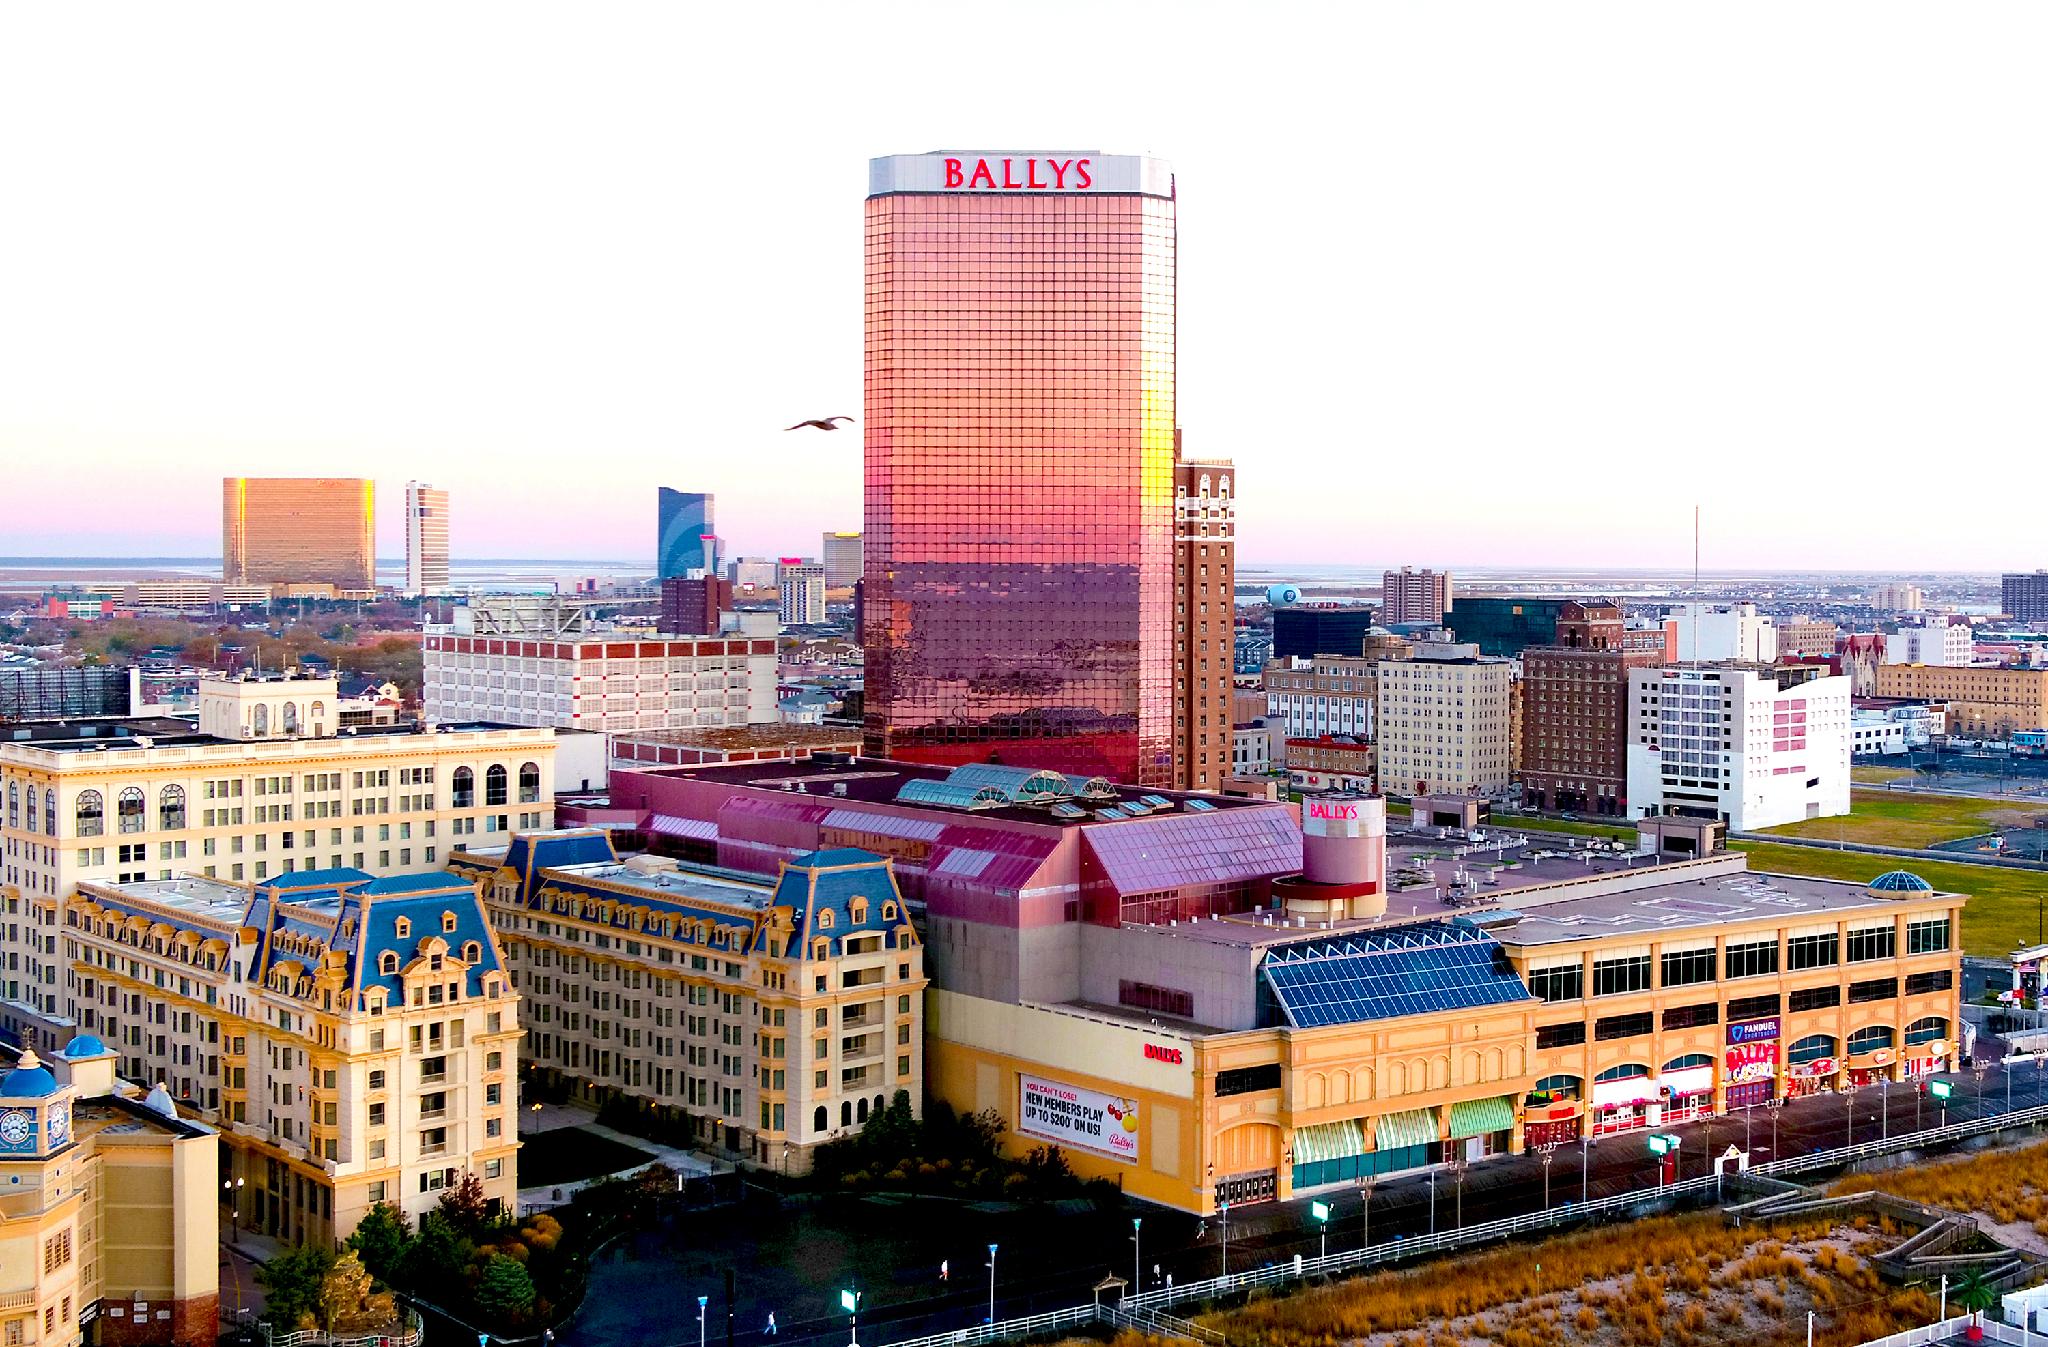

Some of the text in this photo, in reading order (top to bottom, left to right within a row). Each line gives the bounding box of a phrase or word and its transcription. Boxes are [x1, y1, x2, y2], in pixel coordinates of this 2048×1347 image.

[1744, 1021, 1776, 1033] FANDUEL
[1026, 1082, 1077, 1101] YOU CAN'T LOSE!
[1026, 1091, 1103, 1122] NEW MEMBERS PLAY
[1025, 1106, 1036, 1119] UP
[1038, 1109, 1049, 1123] TO
[1074, 1118, 1086, 1132] ON
[1087, 1123, 1101, 1136] US!
